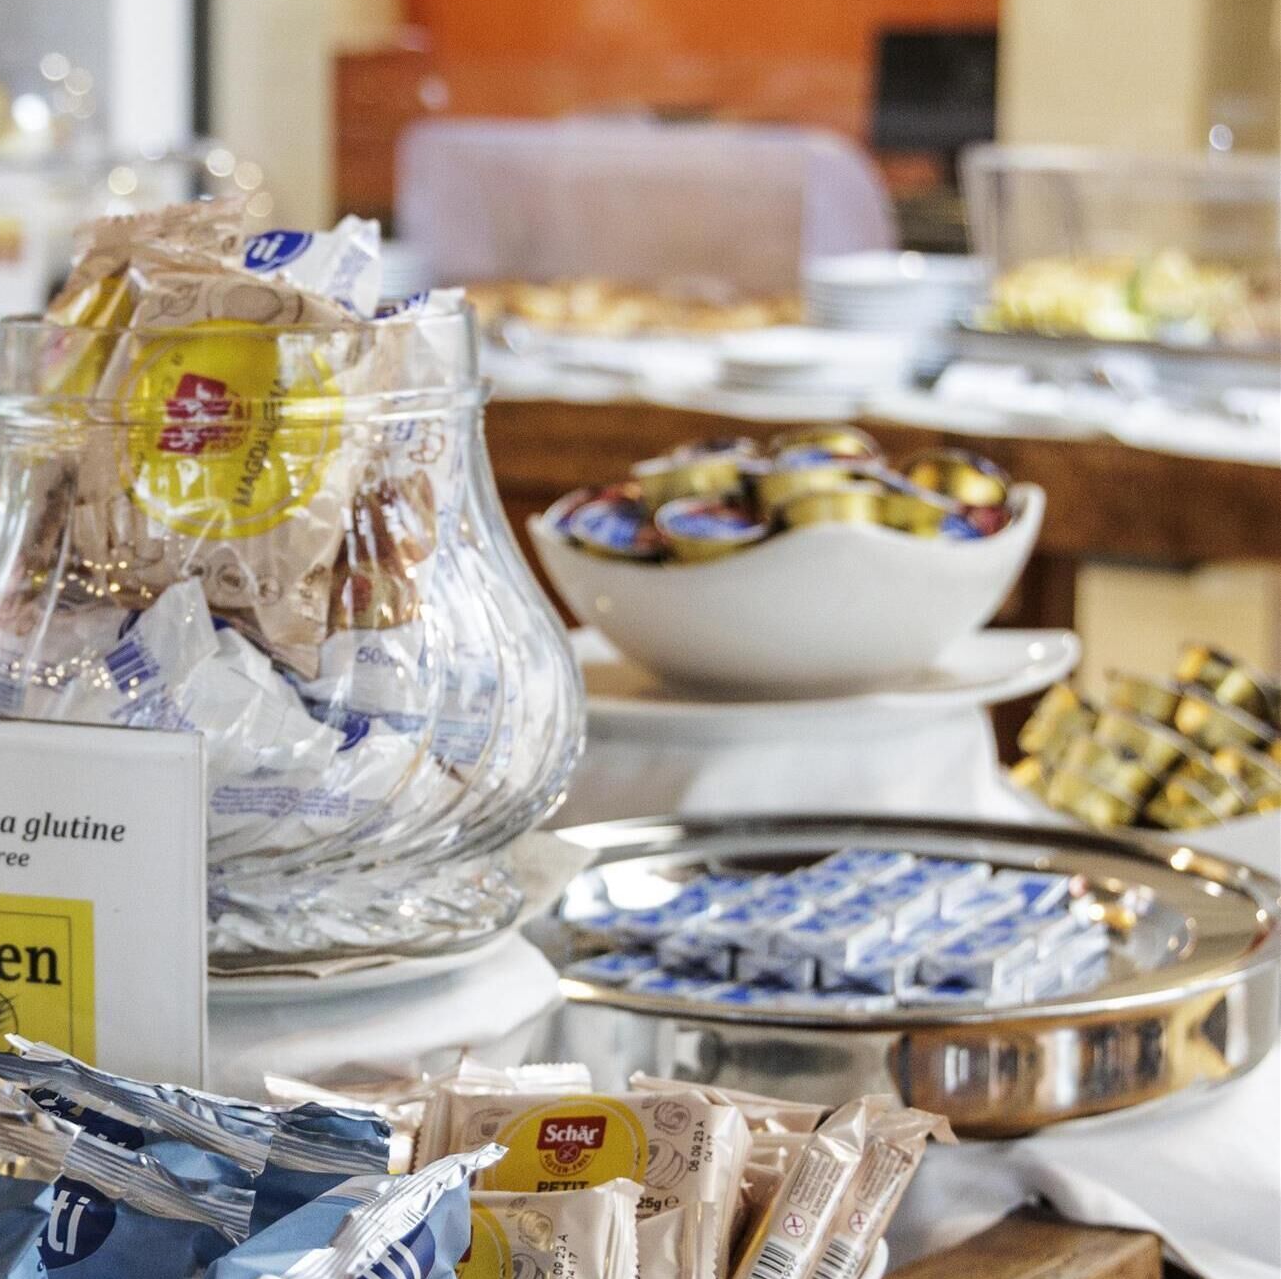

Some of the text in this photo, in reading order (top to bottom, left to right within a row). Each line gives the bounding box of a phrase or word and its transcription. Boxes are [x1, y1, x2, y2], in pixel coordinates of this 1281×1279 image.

[22, 812, 126, 843] glutine
[544, 1123, 600, 1145] Schär
[636, 1197, 662, 1212] 25g
